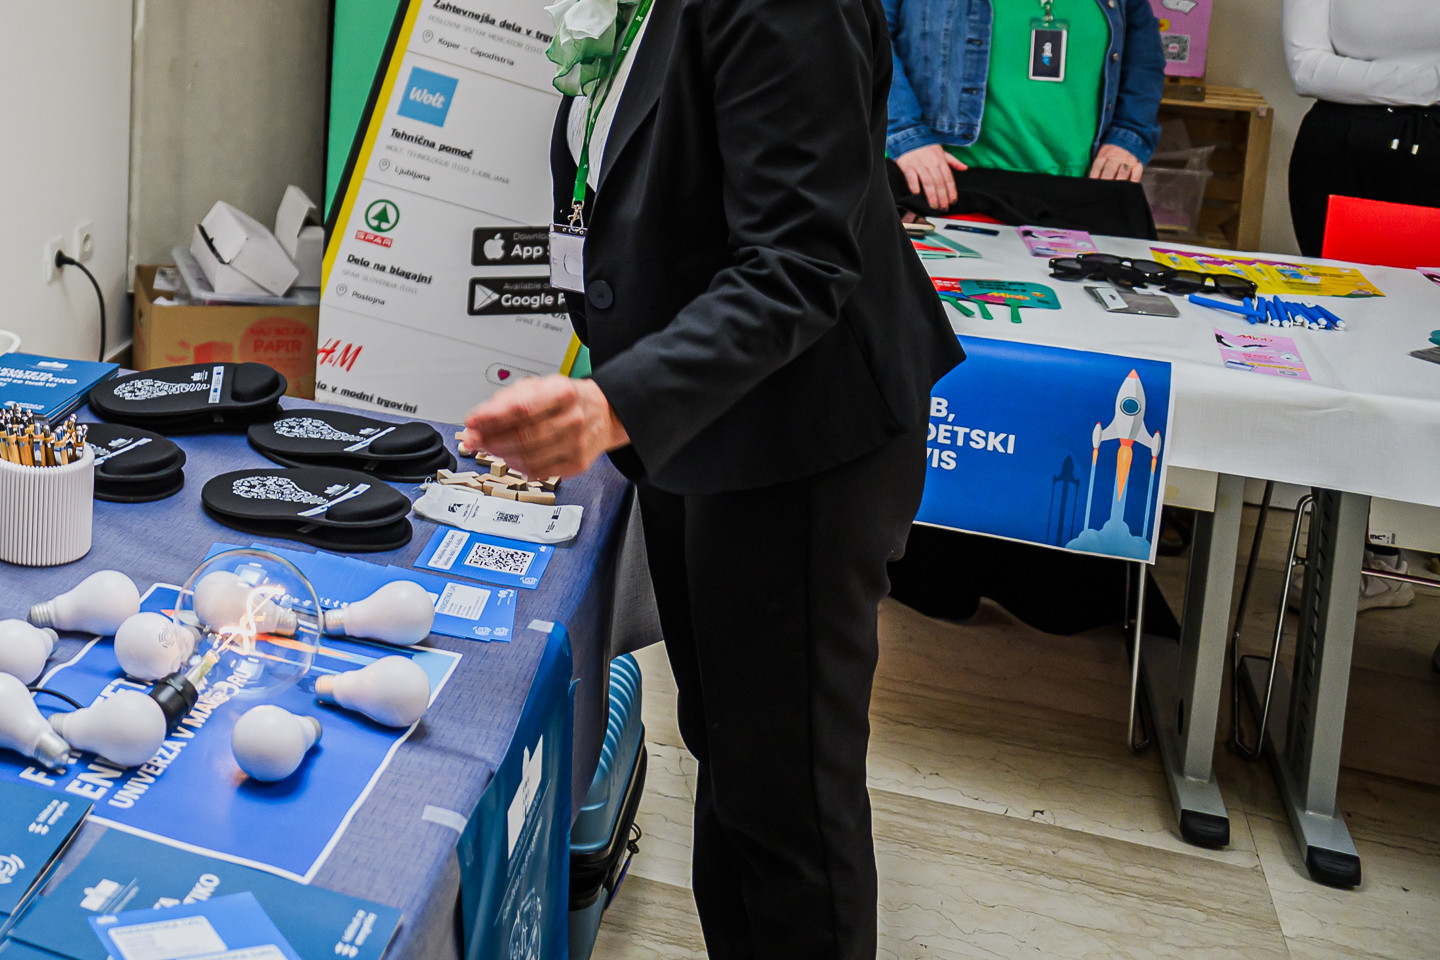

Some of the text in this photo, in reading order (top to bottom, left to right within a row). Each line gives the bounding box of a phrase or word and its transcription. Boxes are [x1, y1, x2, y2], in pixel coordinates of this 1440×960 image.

[433, 0, 496, 25] Zahtevnejša
[499, 19, 522, 33] dela
[525, 28, 533, 36] v
[438, 38, 461, 50] Koper
[470, 47, 515, 66] Capodistria
[409, 86, 446, 109] Wolt
[390, 127, 474, 160] Tehnična pomoč
[394, 166, 431, 182] Ljubljana
[356, 230, 392, 247] SPAR
[510, 243, 543, 259] App
[347, 254, 433, 285] Delo na blagajni
[352, 290, 386, 305] Postojna
[501, 292, 554, 307] Google
[317, 338, 363, 372] H&M
[340, 388, 374, 403] modni
[377, 397, 418, 414] trgovini
[108, 740, 188, 809] UNIVERZA
[171, 725, 195, 739] V
